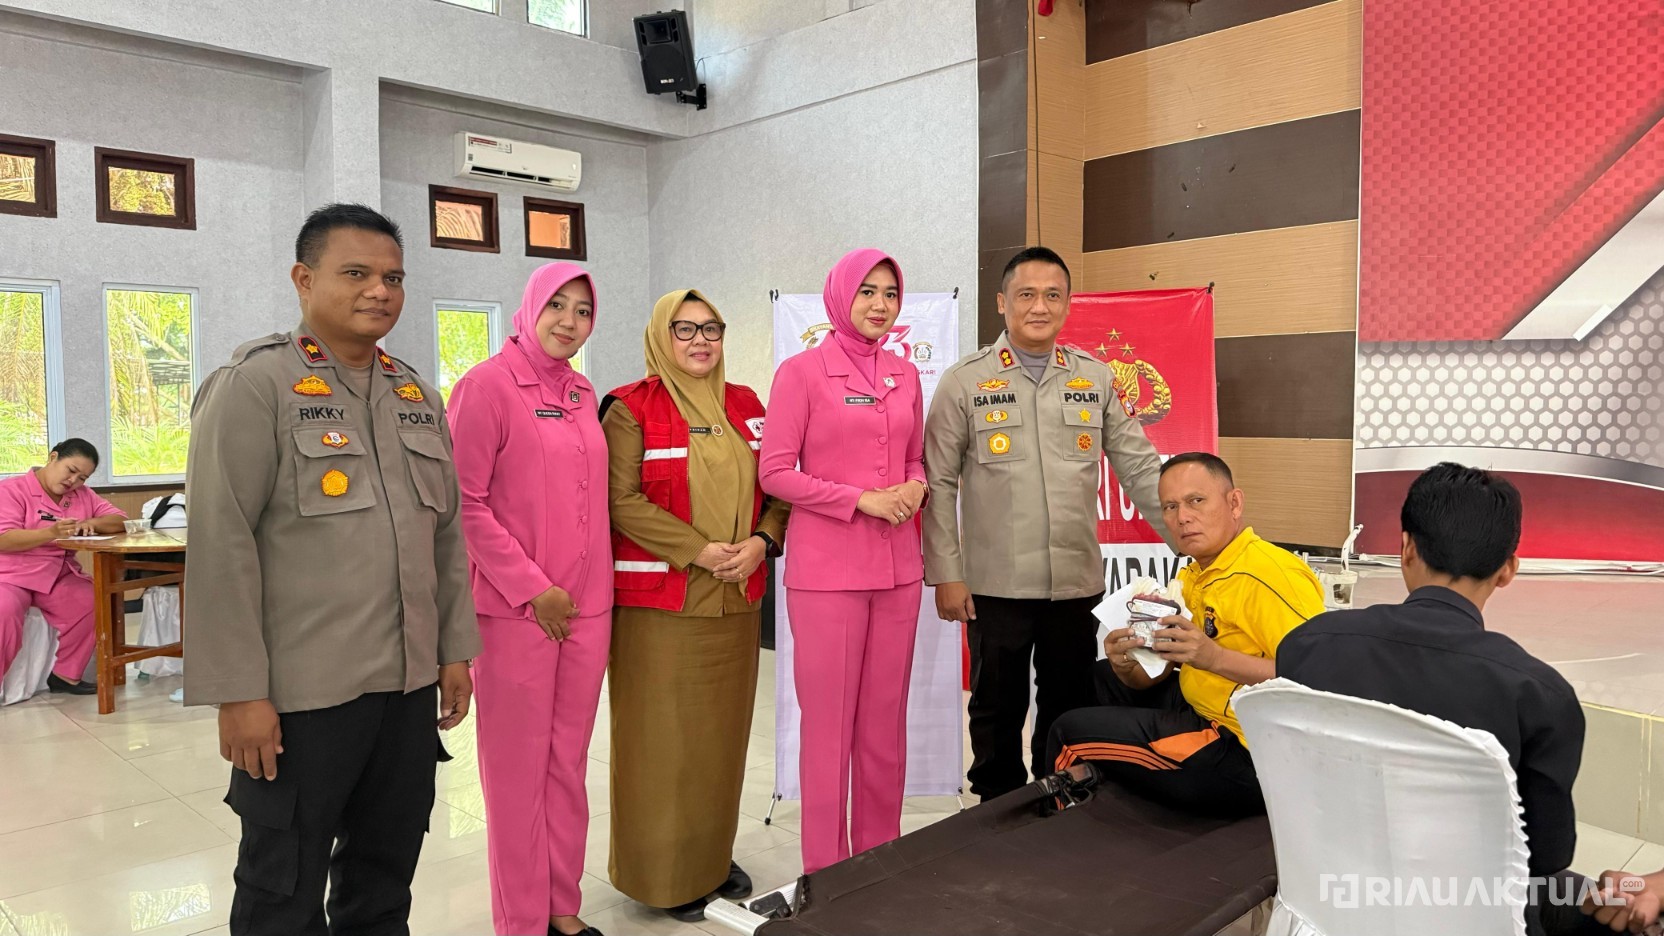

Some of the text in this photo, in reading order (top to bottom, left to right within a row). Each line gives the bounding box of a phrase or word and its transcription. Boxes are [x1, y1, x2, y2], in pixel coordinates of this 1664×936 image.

[974, 394, 1016, 407] ISA IMAM
[1064, 392, 1099, 403] POLRI
[299, 407, 345, 420] RIKKY
[398, 412, 435, 425] POLRI
